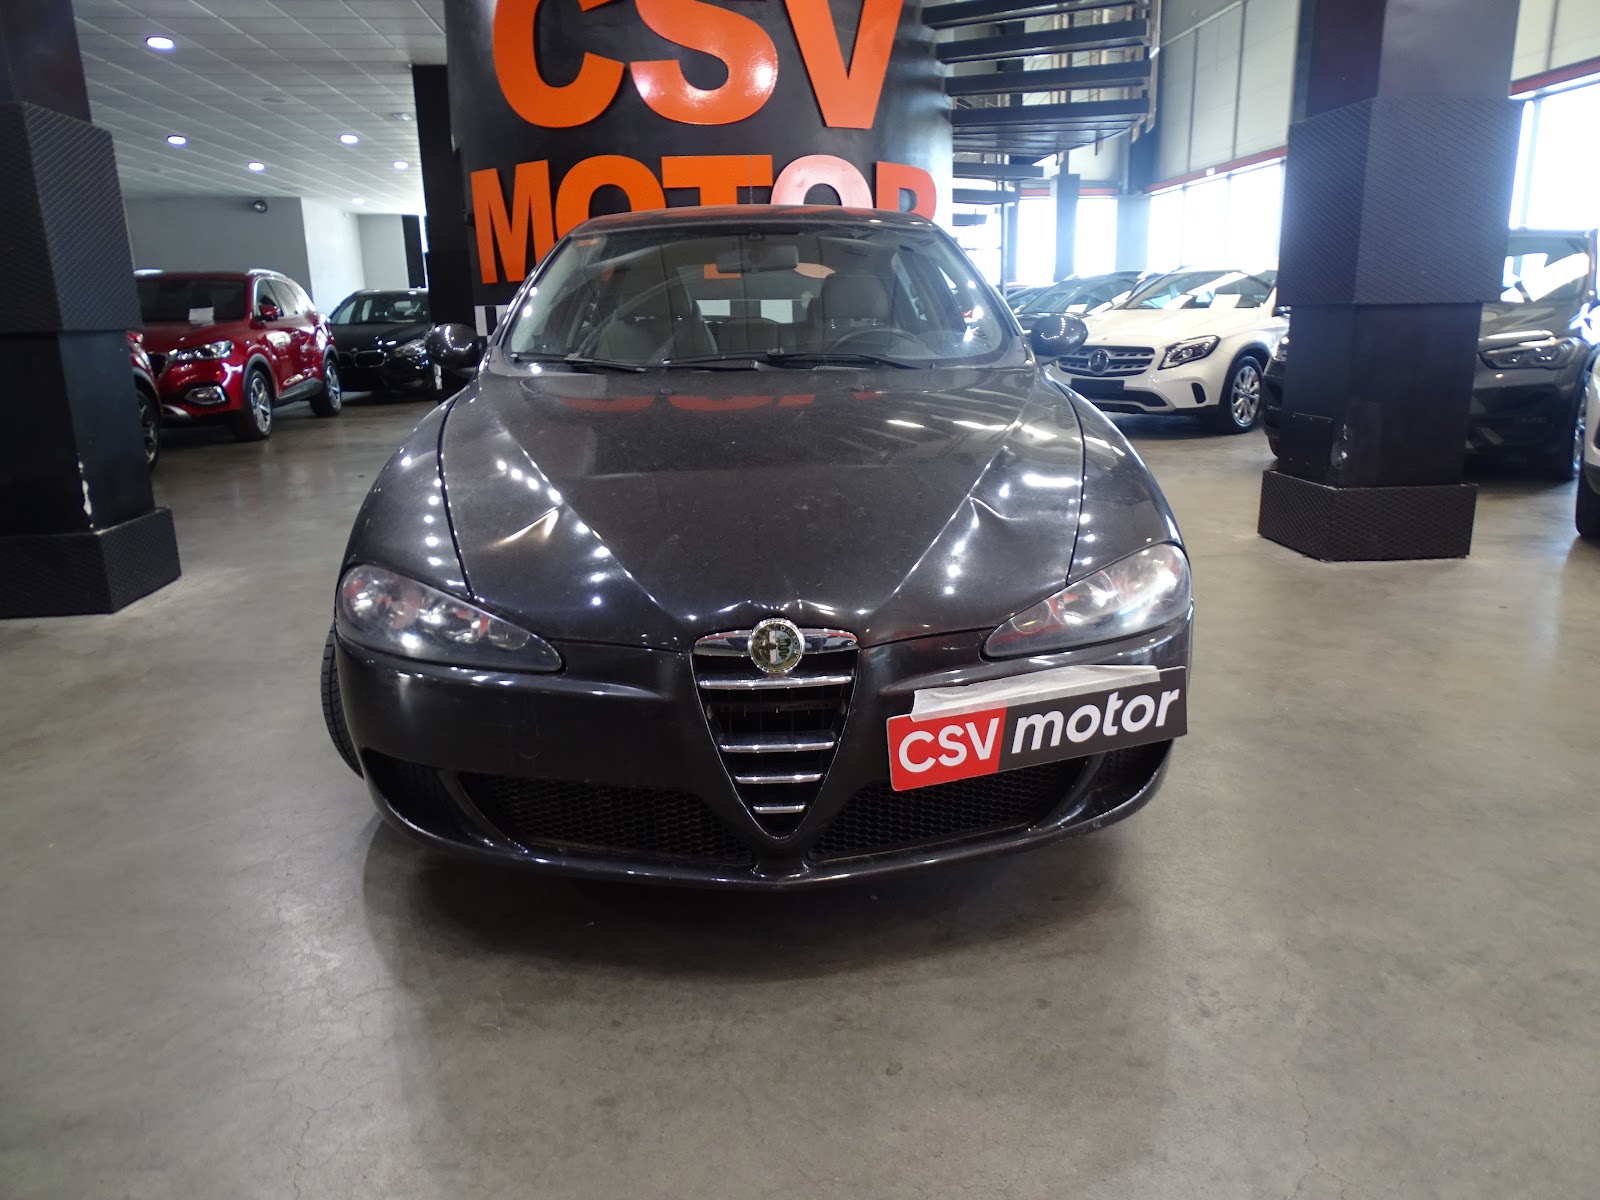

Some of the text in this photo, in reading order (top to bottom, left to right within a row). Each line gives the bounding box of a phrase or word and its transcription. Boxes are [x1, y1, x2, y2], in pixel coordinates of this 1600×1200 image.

[493, 0, 903, 129] CSV
[899, 688, 1180, 773] CSV motor
